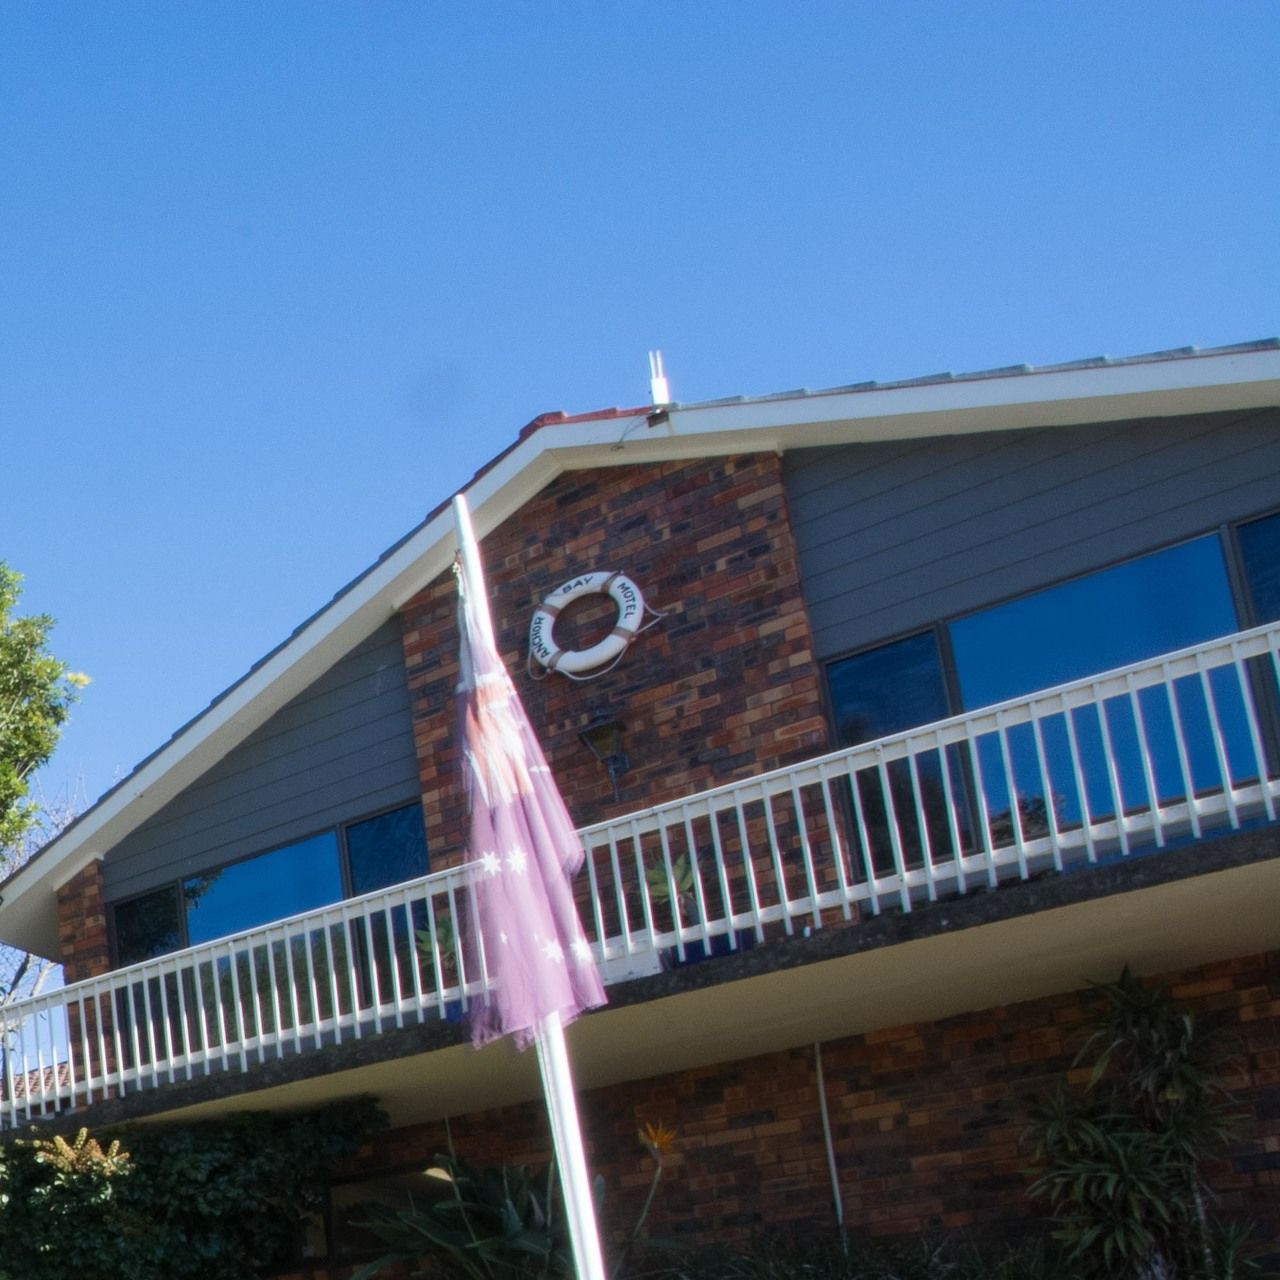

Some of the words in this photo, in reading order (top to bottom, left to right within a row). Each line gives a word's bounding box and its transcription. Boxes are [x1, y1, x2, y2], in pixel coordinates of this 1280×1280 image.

[531, 616, 550, 659] ANCHOR
[562, 576, 594, 594] BAY
[617, 582, 638, 619] MOTEL
